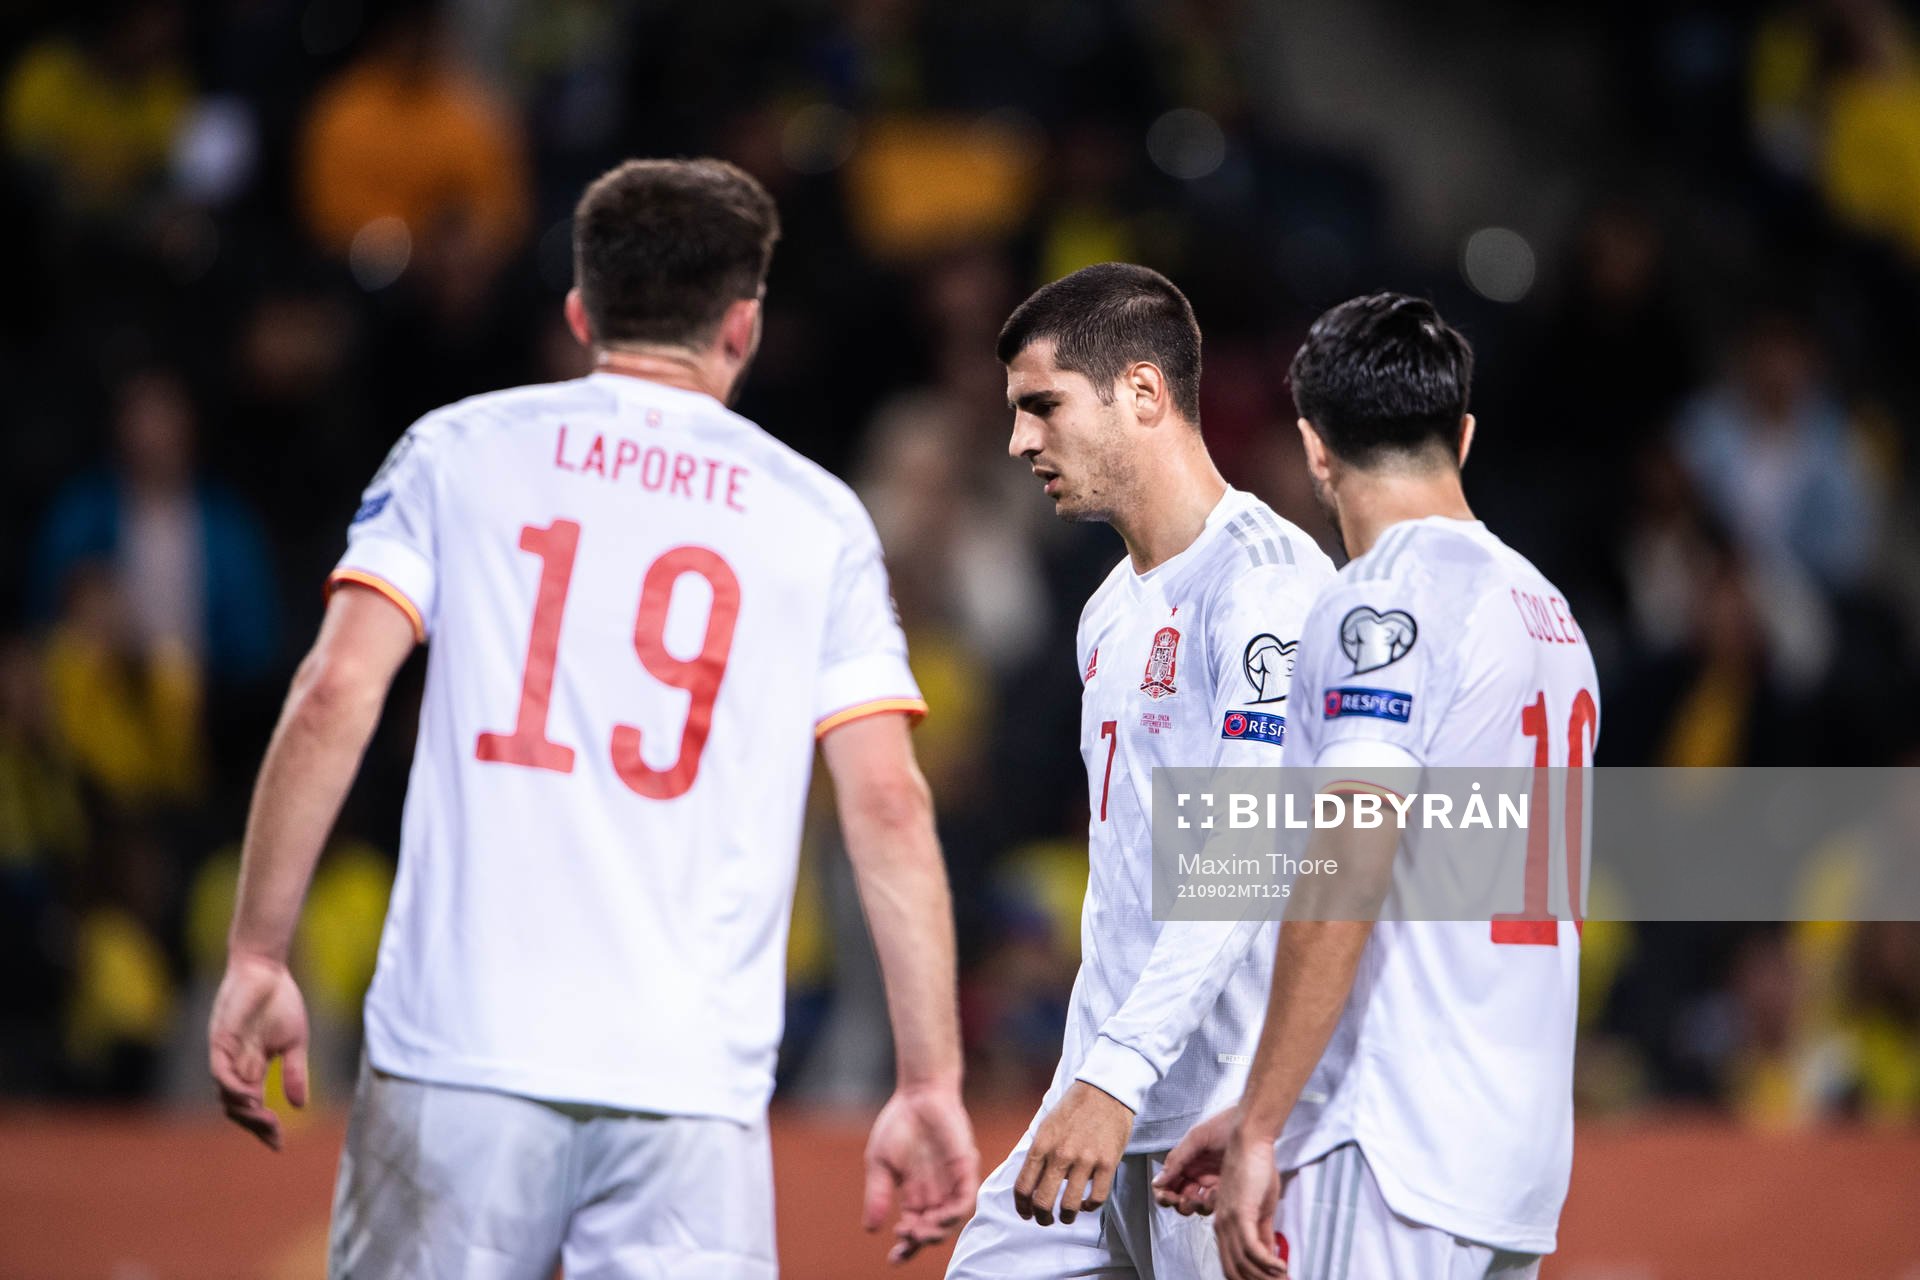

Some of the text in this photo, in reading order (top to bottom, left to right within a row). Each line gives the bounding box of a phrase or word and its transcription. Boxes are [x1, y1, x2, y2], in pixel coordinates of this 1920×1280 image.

[554, 424, 749, 512] LAPORTE
[475, 518, 741, 801] 19
[1342, 694, 1411, 717] RESPECT
[1100, 720, 1118, 822] 7
[1490, 687, 1597, 947] 10
